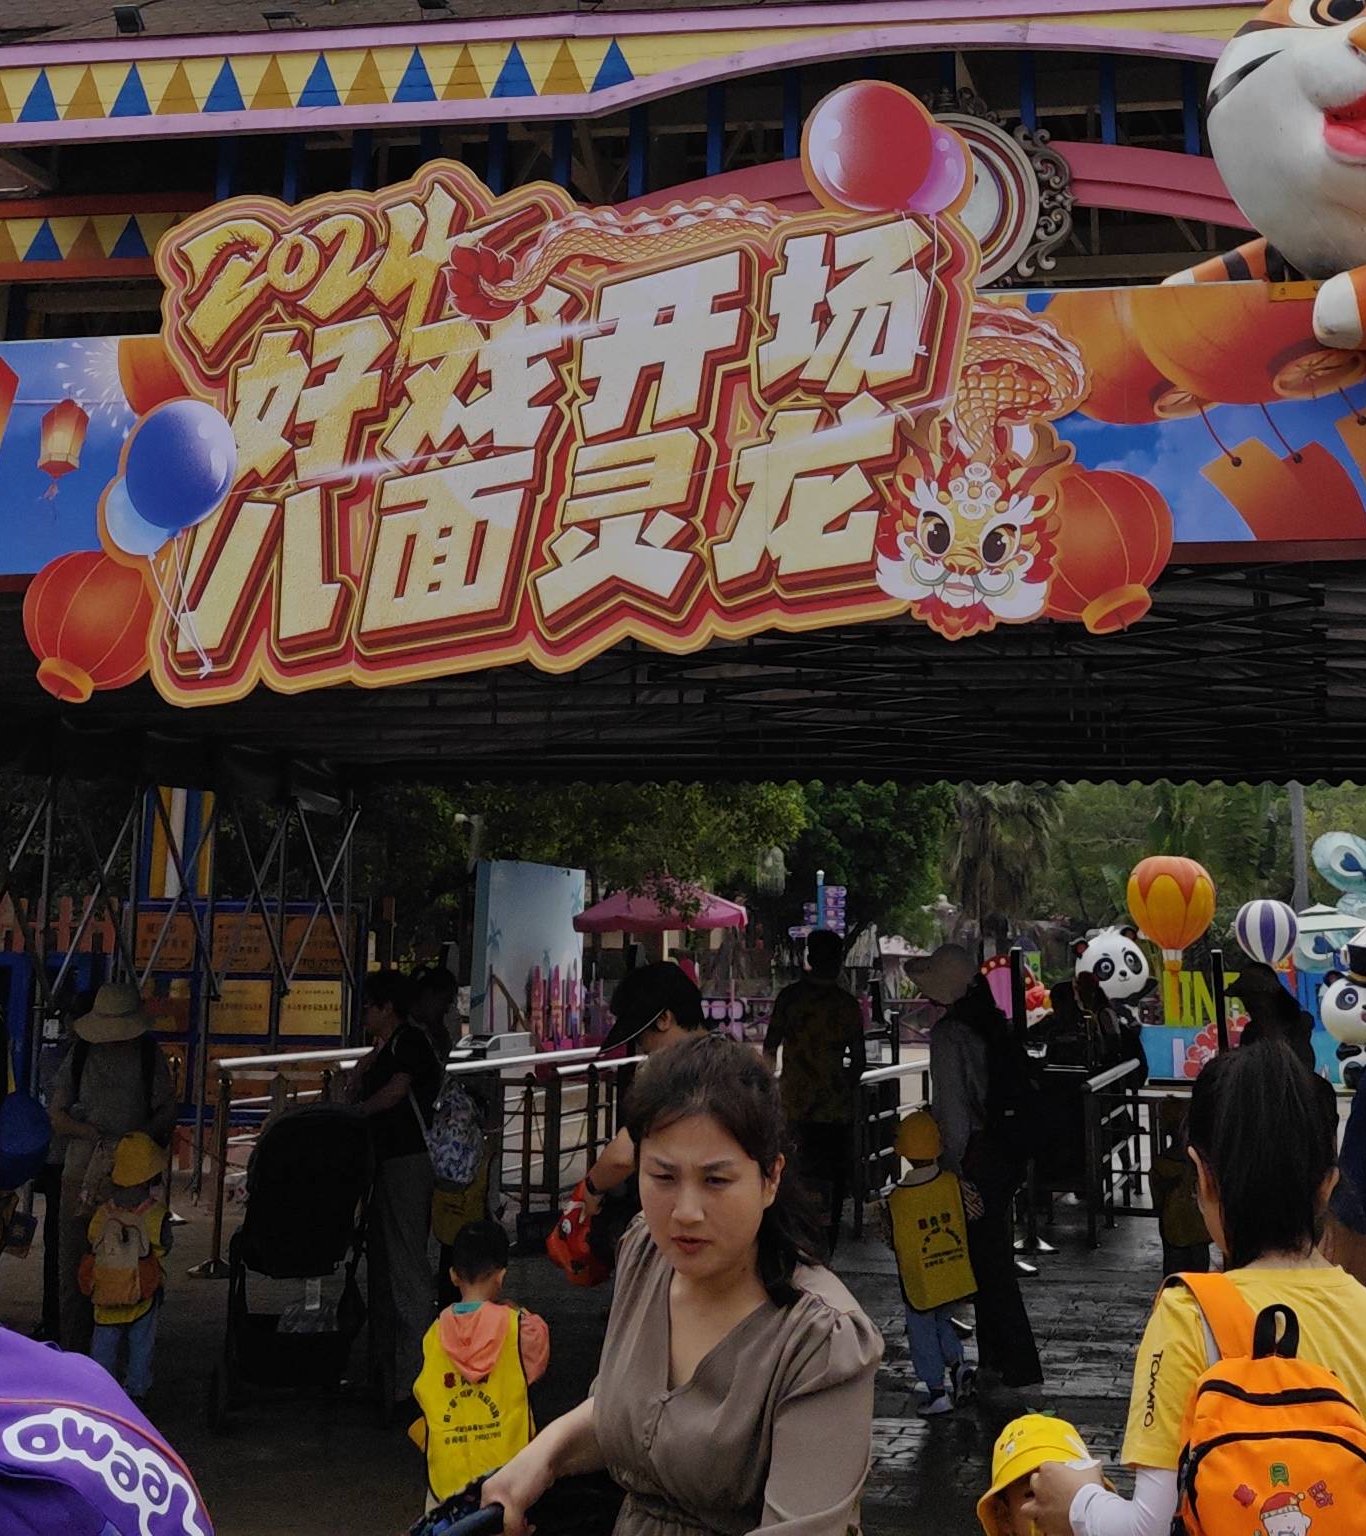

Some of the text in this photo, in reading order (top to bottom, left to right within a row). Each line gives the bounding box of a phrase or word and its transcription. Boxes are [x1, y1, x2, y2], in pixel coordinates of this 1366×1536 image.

[180, 182, 535, 376] 2024
[233, 230, 937, 478] 好戏开场
[175, 392, 903, 654] 八面灵龙
[1143, 1350, 1164, 1428] TOMATO
